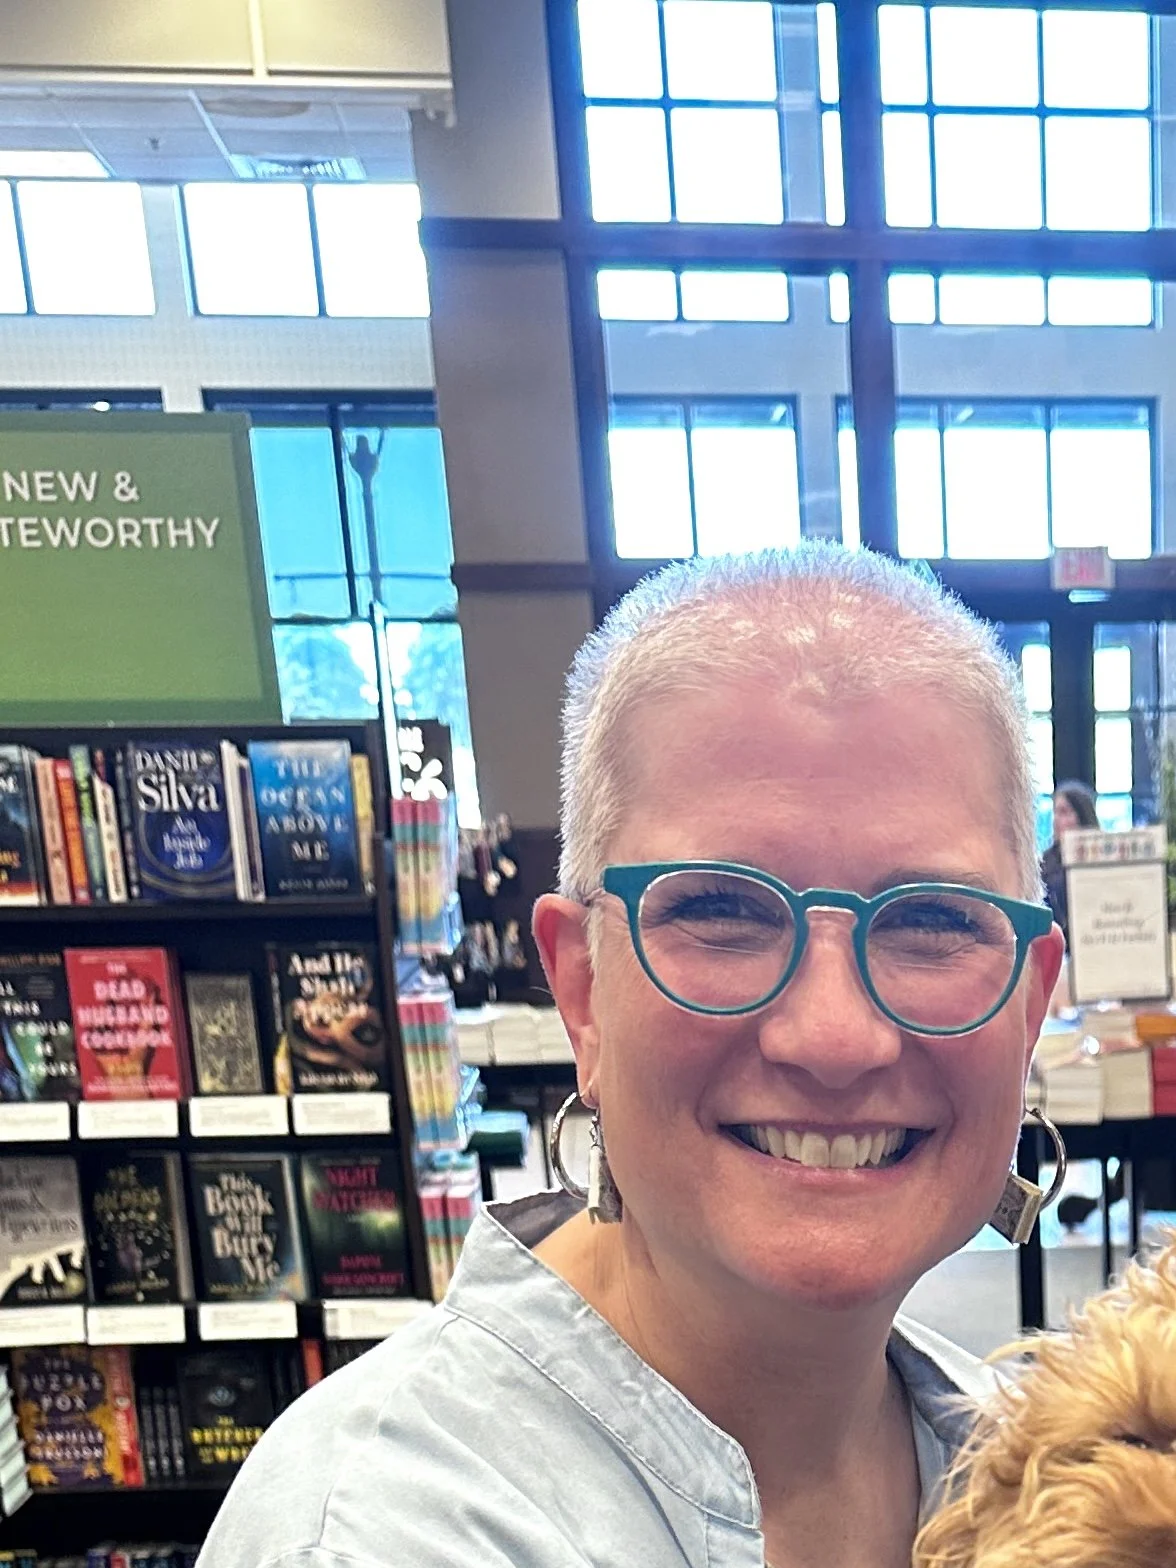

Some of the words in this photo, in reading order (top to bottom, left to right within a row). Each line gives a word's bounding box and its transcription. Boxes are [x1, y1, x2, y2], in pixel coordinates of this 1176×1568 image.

[2, 470, 97, 502] NEW
[113, 470, 140, 502] &
[0, 516, 220, 549] TEWORTHY
[134, 750, 216, 772] DANI
[136, 769, 221, 813] Silva
[261, 784, 346, 807] OCEAN
[266, 814, 347, 835] ABOVE
[291, 840, 330, 861] ME
[287, 952, 332, 977] And
[92, 979, 147, 1001] DEAD
[204, 1184, 275, 1217] Book
[214, 1446, 252, 1463] WRE
